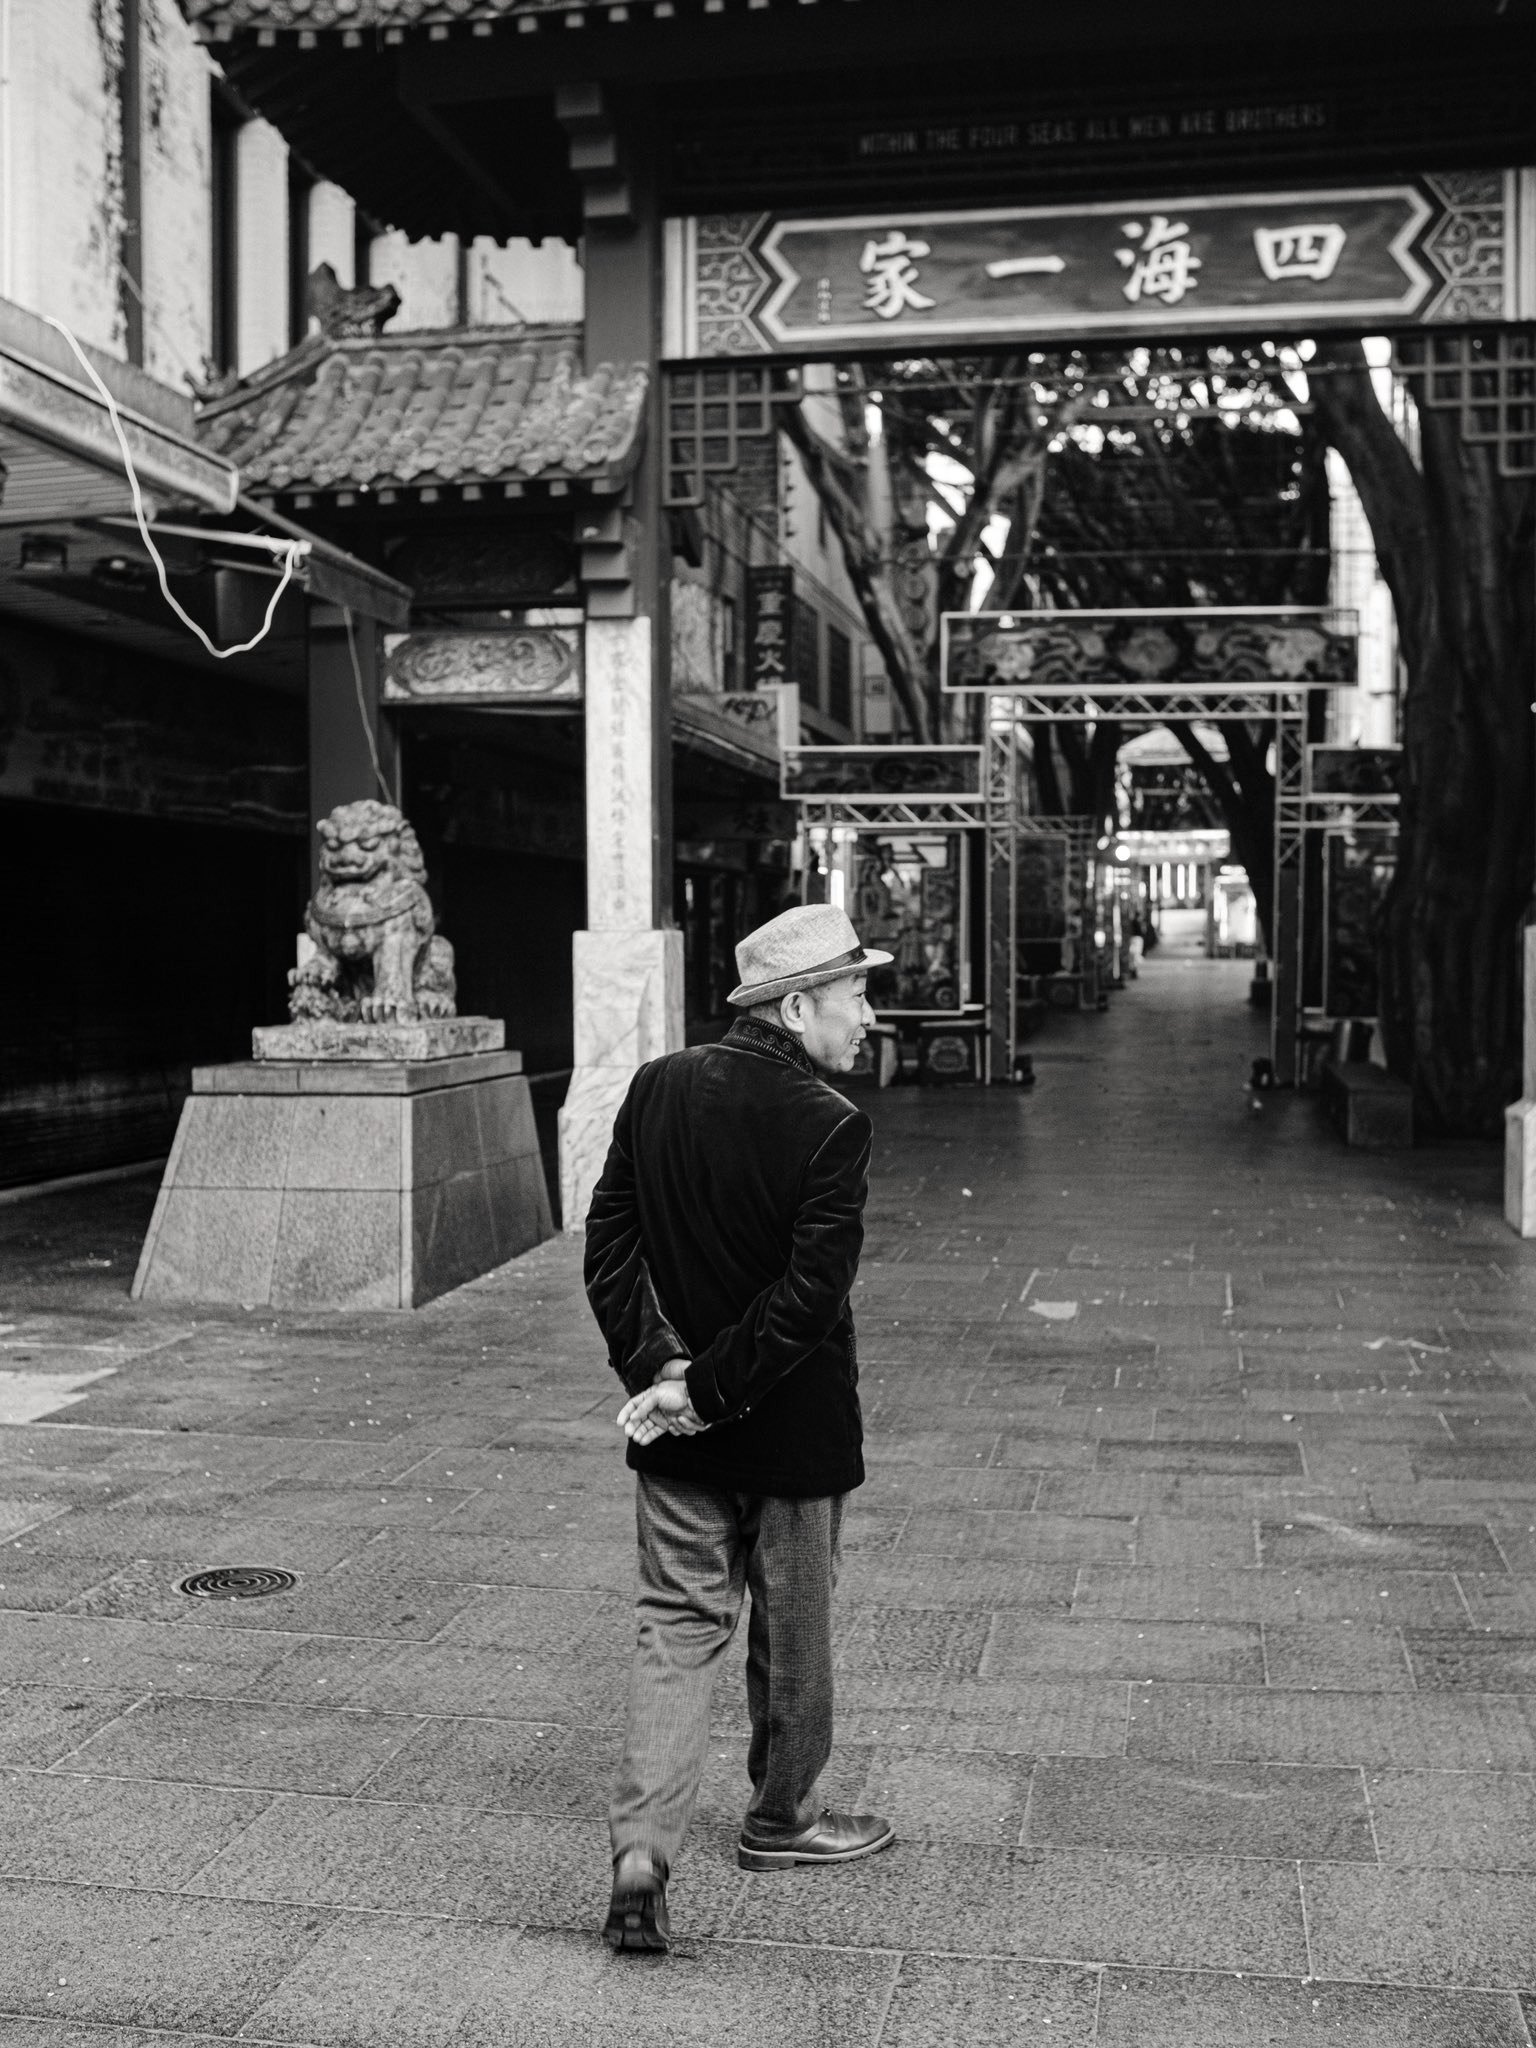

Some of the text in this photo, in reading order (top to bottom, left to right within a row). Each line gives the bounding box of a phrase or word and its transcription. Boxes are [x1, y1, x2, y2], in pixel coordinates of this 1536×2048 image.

[926, 128, 961, 150] THE
[968, 124, 1018, 147] FOUR
[1027, 120, 1077, 145] SEAS
[1084, 116, 1120, 140] ALL
[1128, 114, 1170, 138] MEN
[1179, 110, 1215, 135] ARE
[1225, 103, 1326, 133] BROTHERS
[859, 215, 1347, 320] 四海一家
